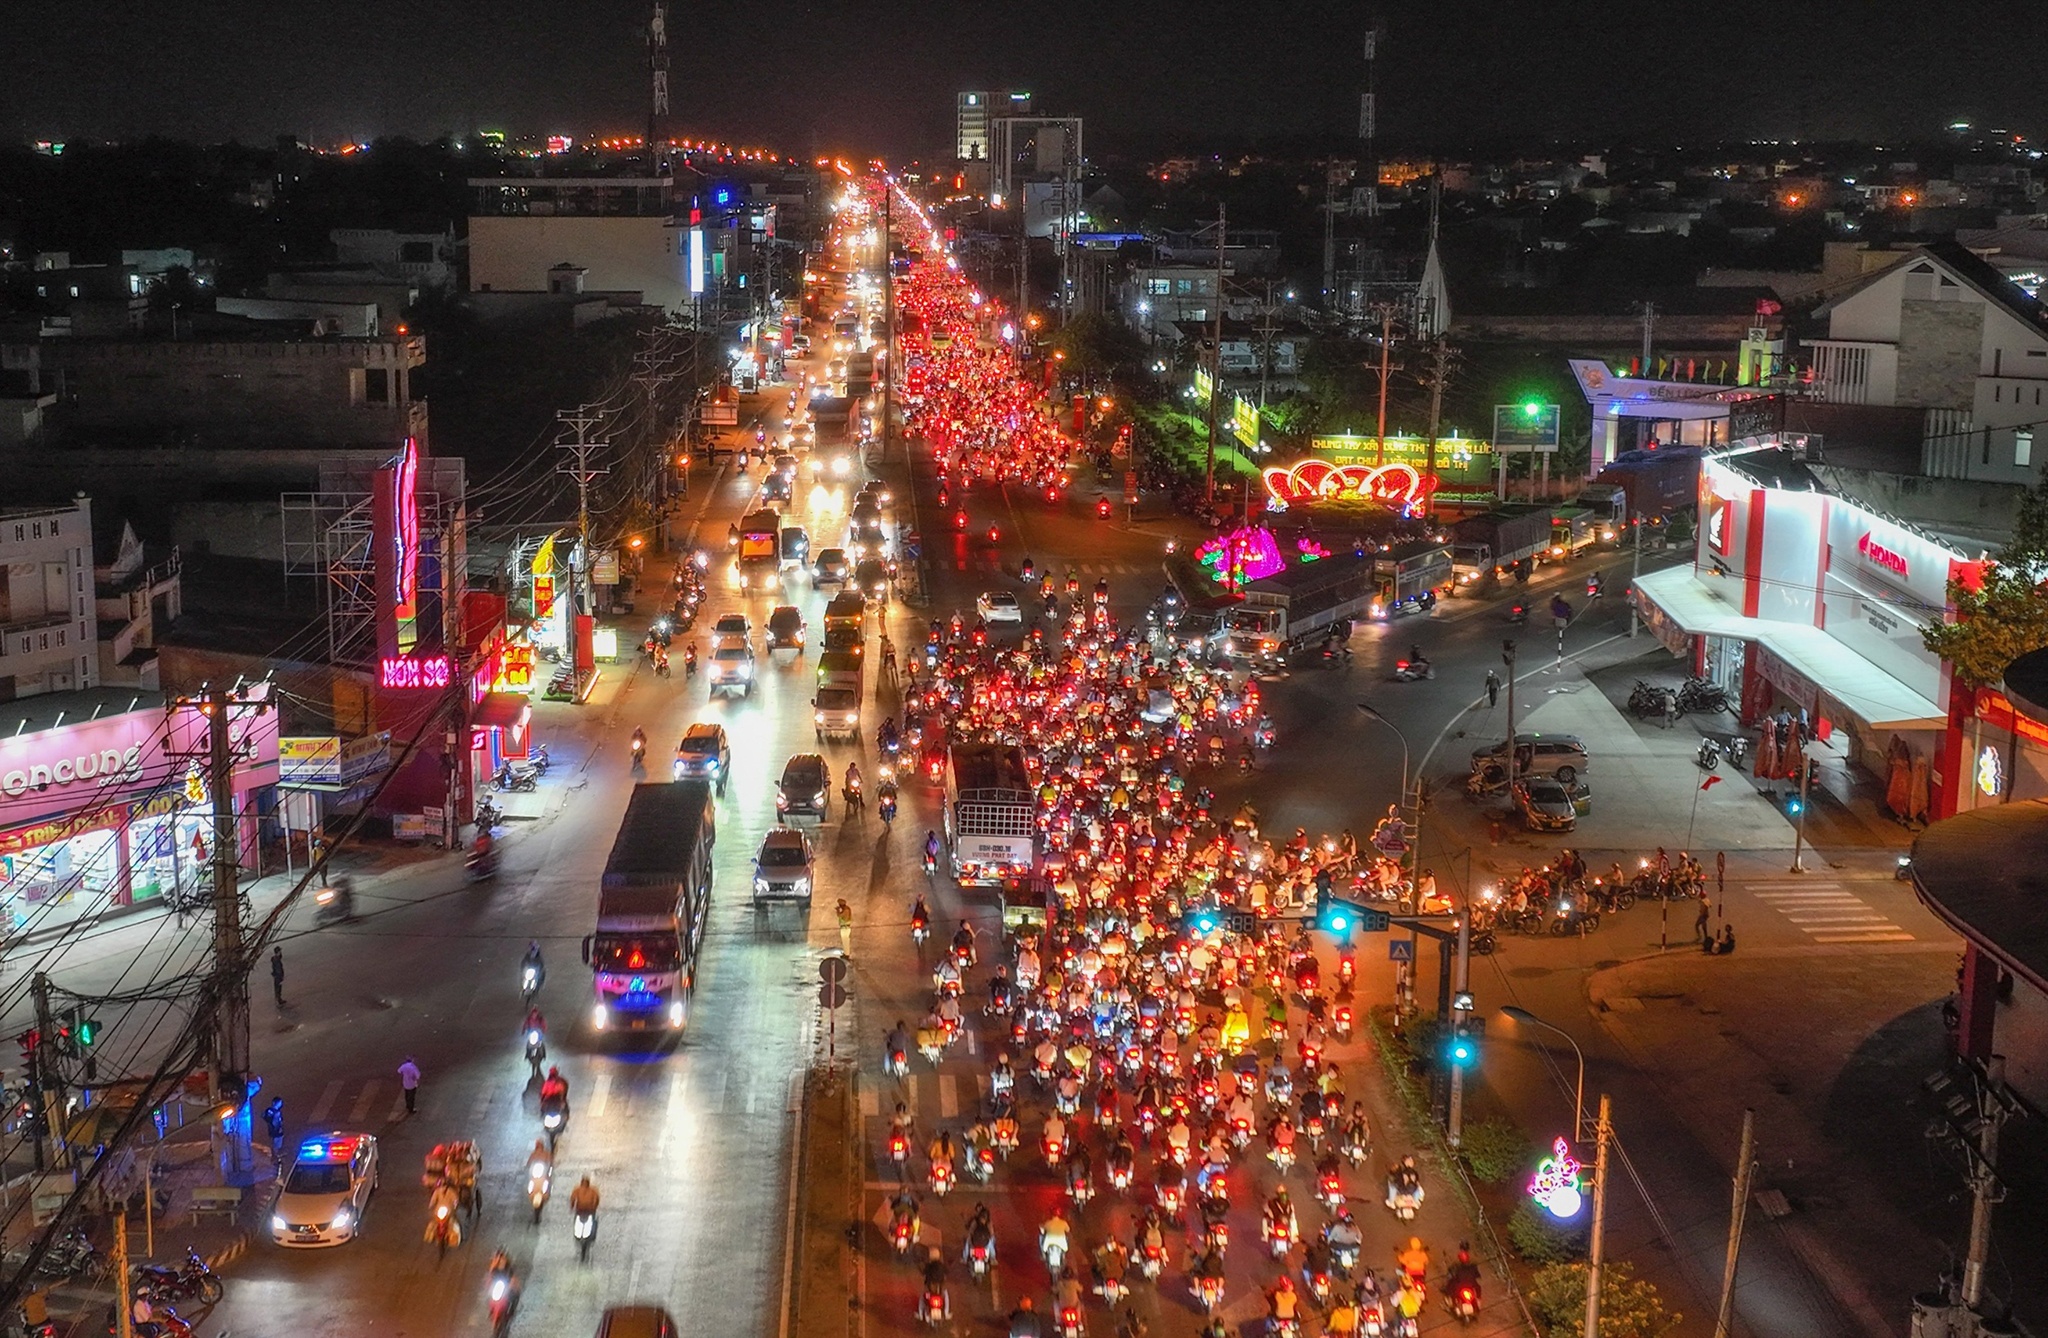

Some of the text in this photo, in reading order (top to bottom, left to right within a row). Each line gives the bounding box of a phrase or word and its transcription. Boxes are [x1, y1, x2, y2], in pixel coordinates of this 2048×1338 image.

[1869, 541, 1909, 577] HONDA
[382, 654, 420, 688] NÓN
[424, 656, 457, 688] SƠ
[0, 741, 143, 796] oncung
